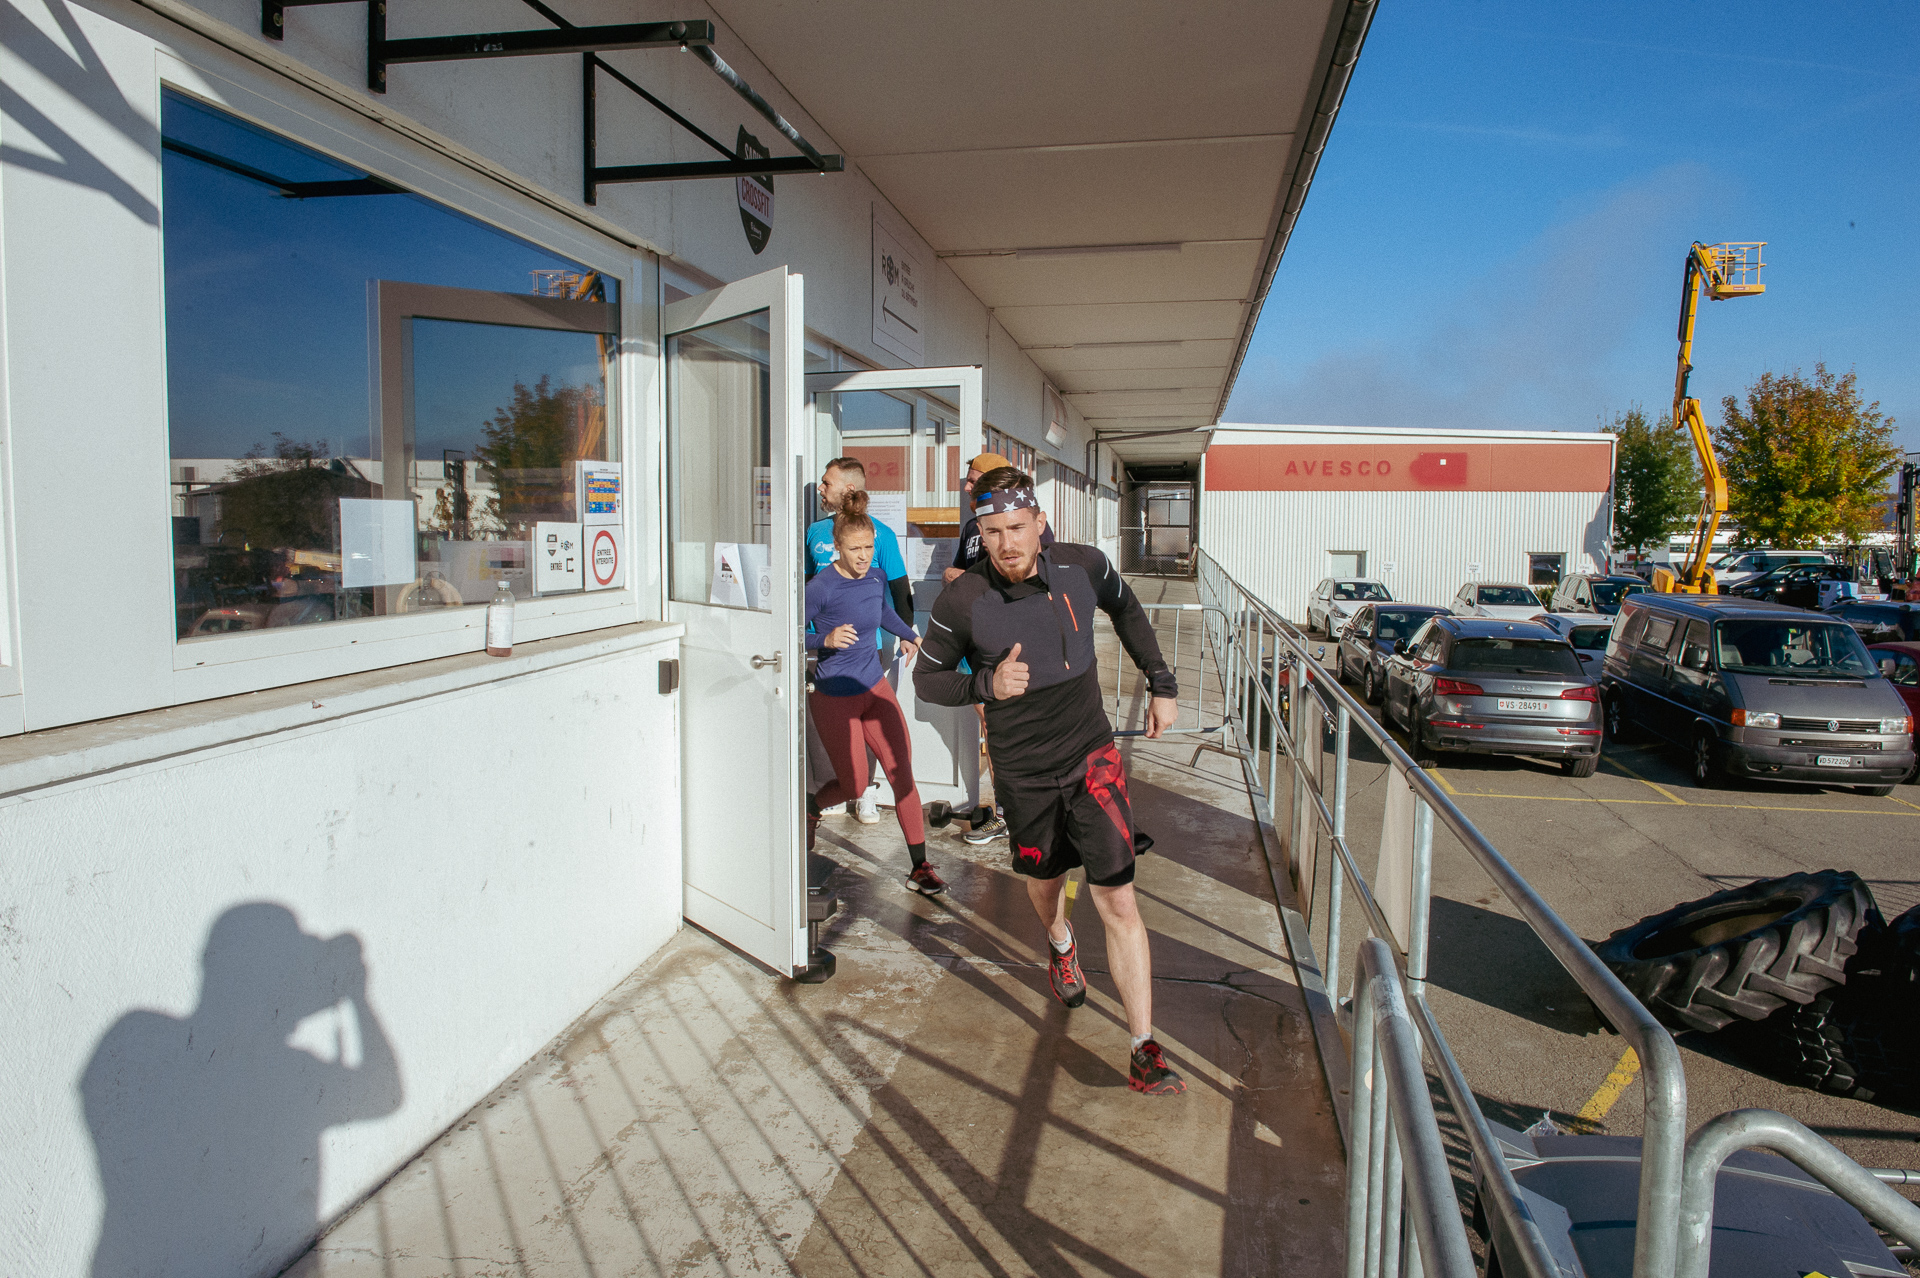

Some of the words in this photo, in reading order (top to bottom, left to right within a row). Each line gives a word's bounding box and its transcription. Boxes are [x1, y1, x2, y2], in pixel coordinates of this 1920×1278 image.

[742, 177, 770, 218] CROSSFIT
[1285, 460, 1391, 477] AVESCO
[966, 534, 981, 549] LIFT
[597, 548, 612, 557] ENTRÉE
[1505, 700, 1515, 709] VS
[1518, 701, 1541, 711] 28491
